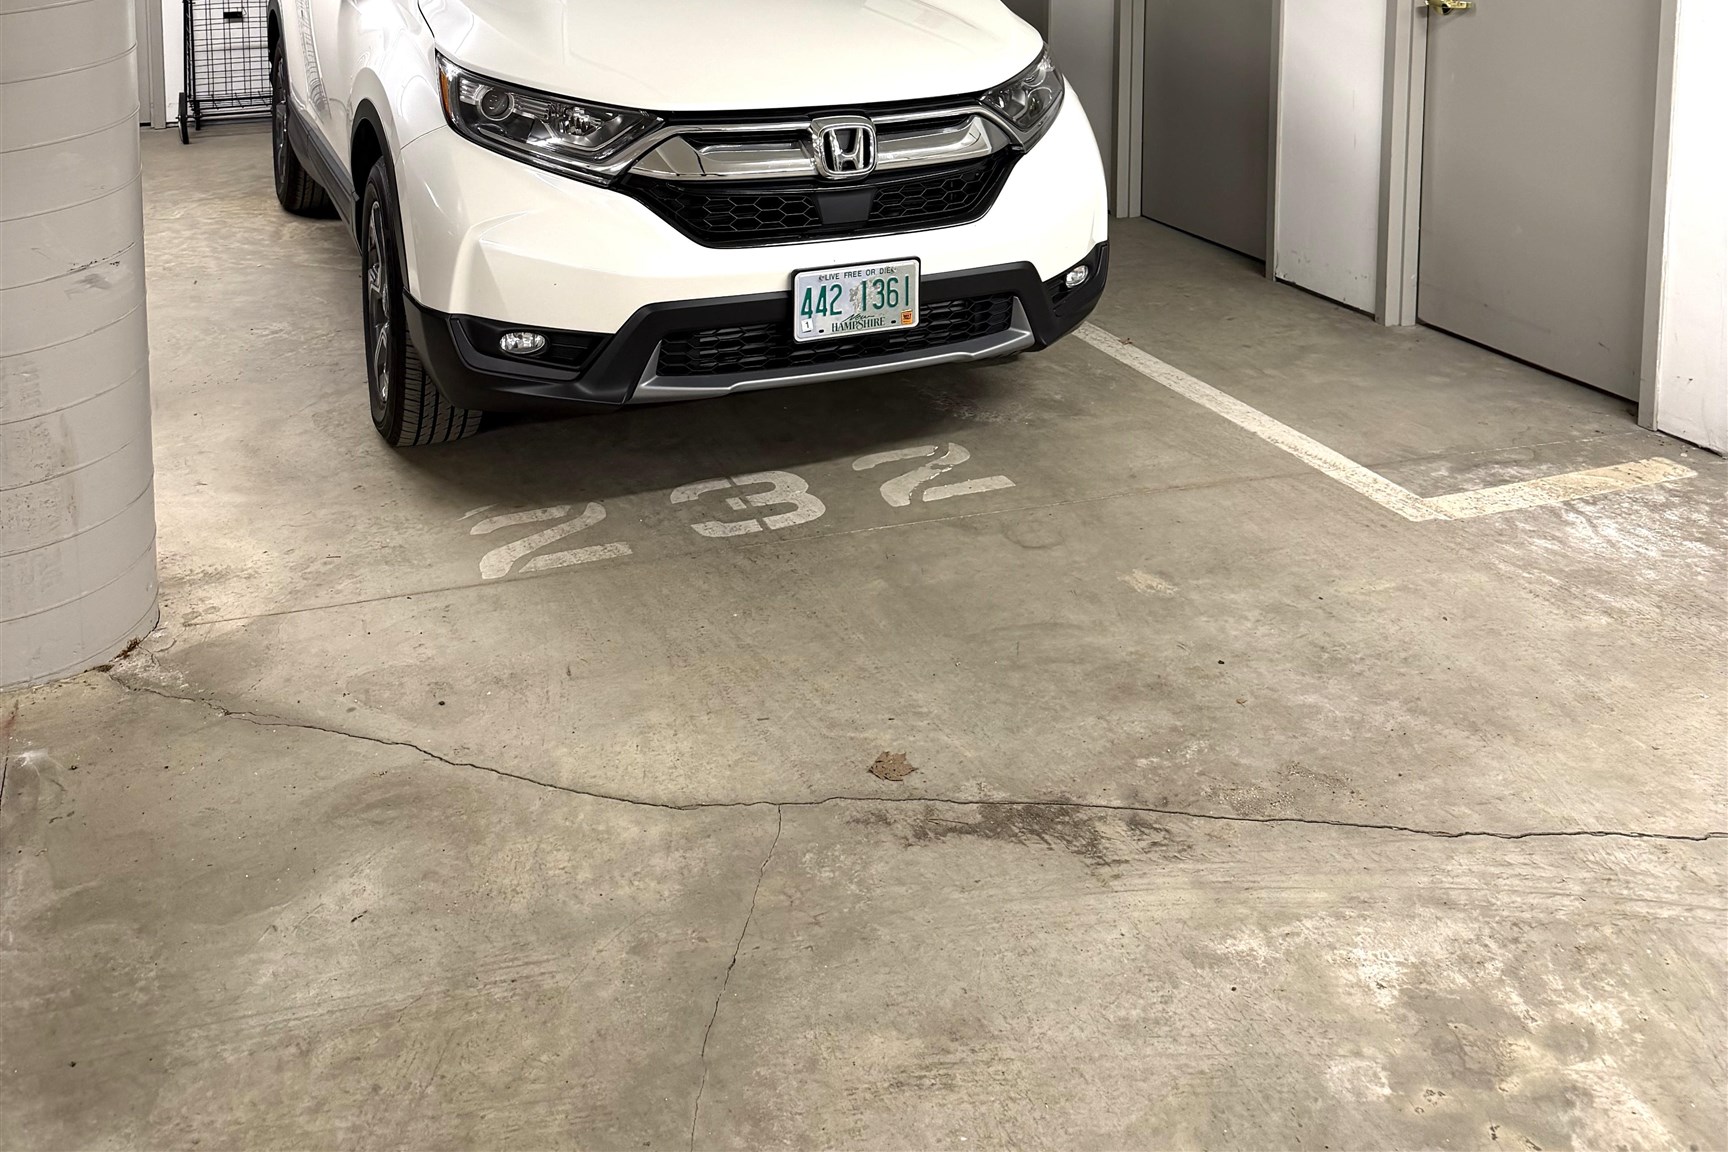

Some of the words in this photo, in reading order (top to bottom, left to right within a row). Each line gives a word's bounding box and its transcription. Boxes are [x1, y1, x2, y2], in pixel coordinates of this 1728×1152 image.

[824, 272, 840, 281] LIVE
[843, 270, 862, 279] FREE
[865, 268, 876, 277] OR
[879, 266, 891, 275] DIE
[801, 283, 843, 318] 442
[861, 275, 909, 312] 1361
[831, 317, 886, 332] HAMPSHIRE
